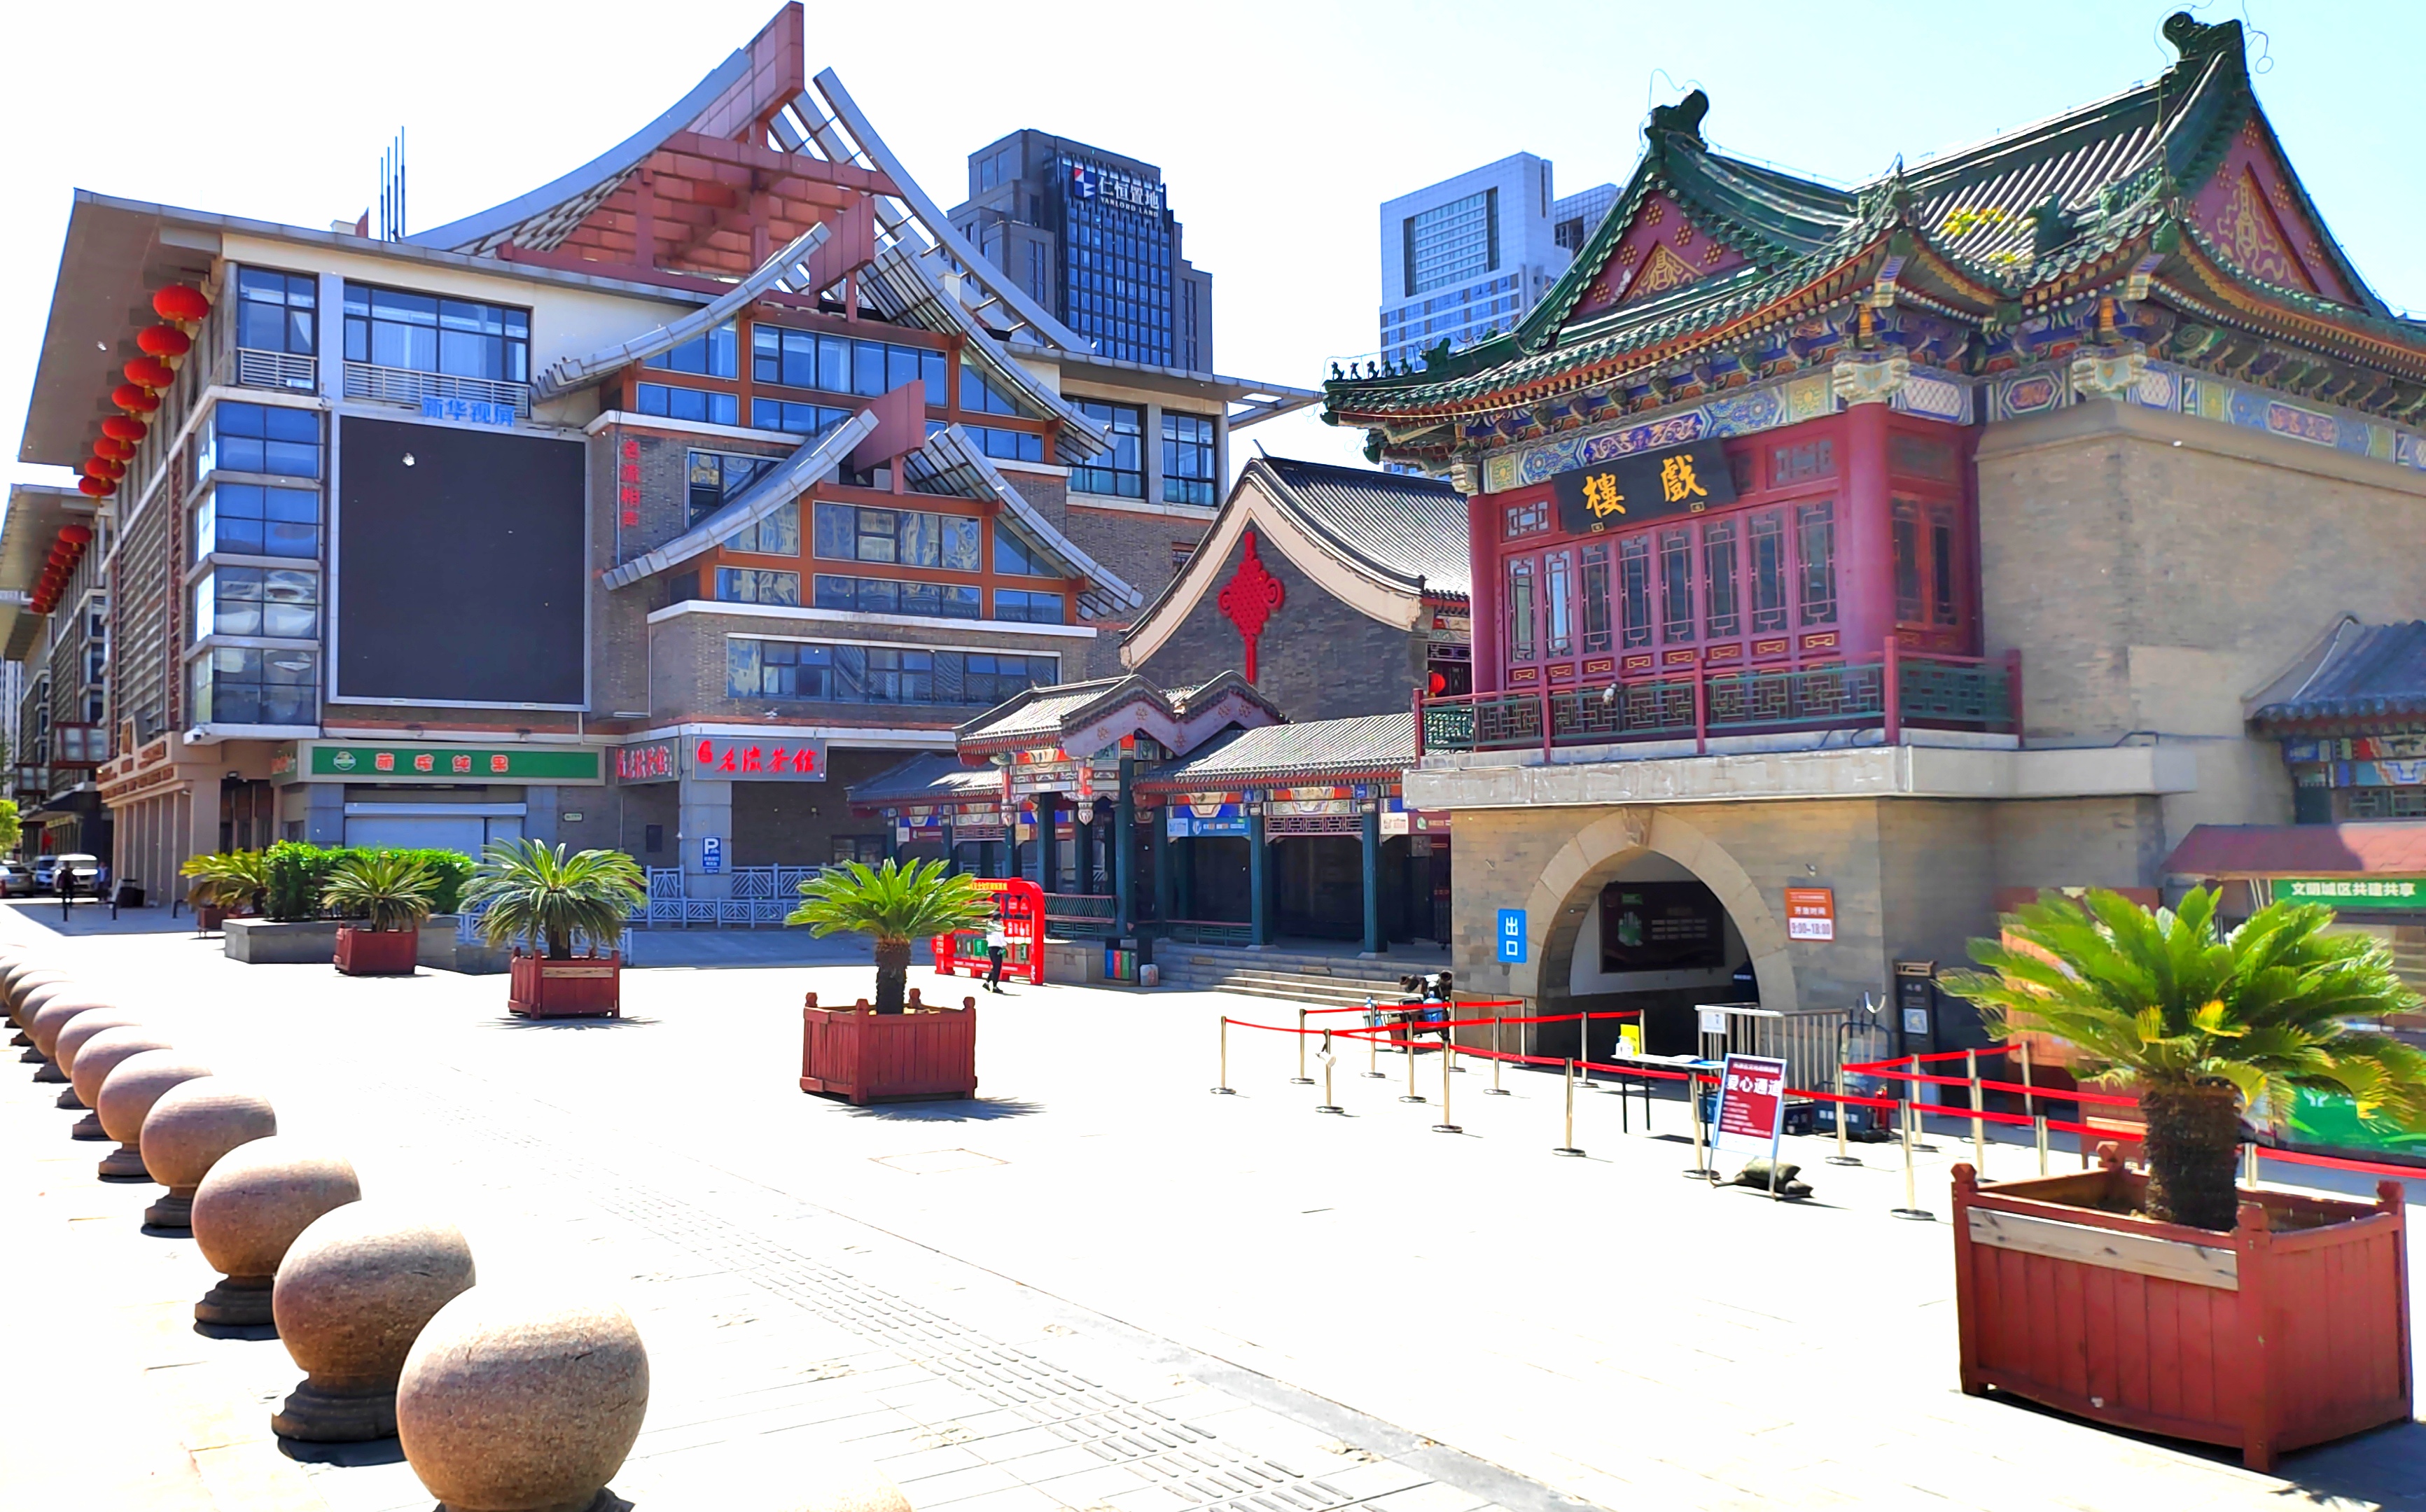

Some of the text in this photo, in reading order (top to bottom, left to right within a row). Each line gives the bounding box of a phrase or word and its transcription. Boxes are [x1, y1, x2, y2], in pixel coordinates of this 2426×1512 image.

[1099, 176, 1159, 209] 仁恒置地
[1100, 196, 1159, 218] YANLORD LAND
[421, 396, 515, 427] 新华视屏
[704, 838, 719, 855] P
[2291, 881, 2415, 897] 文明城区共建共享
[1505, 916, 1519, 956] 出口
[1725, 1074, 1783, 1098] 爱心通道
